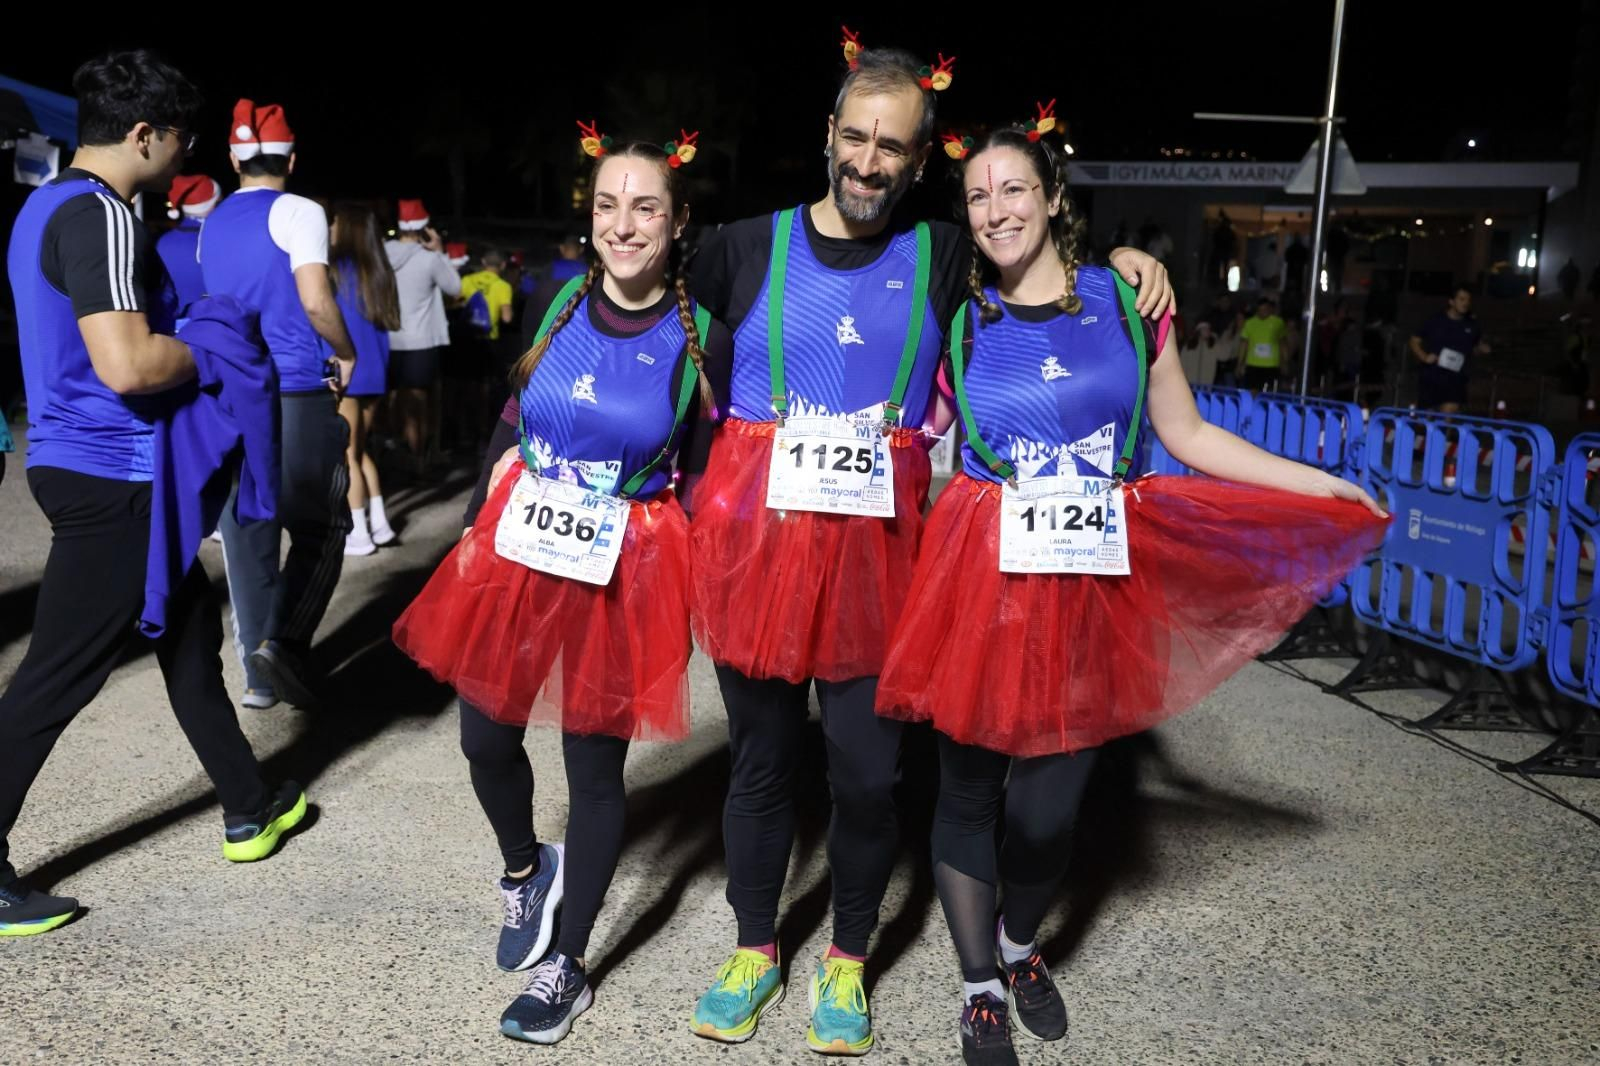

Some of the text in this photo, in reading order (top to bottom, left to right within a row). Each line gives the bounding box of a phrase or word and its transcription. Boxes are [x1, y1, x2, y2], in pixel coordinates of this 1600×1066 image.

[1152, 163, 1222, 181] MÁLAGA
[1101, 427, 1113, 438] VI
[1074, 441, 1091, 449] SAN
[1074, 444, 1112, 456] SILVESTRE
[789, 442, 873, 474] 1125
[576, 464, 615, 481] SILVESTRE
[604, 461, 619, 472] VI
[820, 486, 862, 498] mayoral
[523, 502, 597, 542] 1036
[1020, 504, 1105, 532] 1124
[538, 538, 555, 547] ALBA
[538, 545, 580, 563] mayoral
[1053, 547, 1096, 558] mayoral
